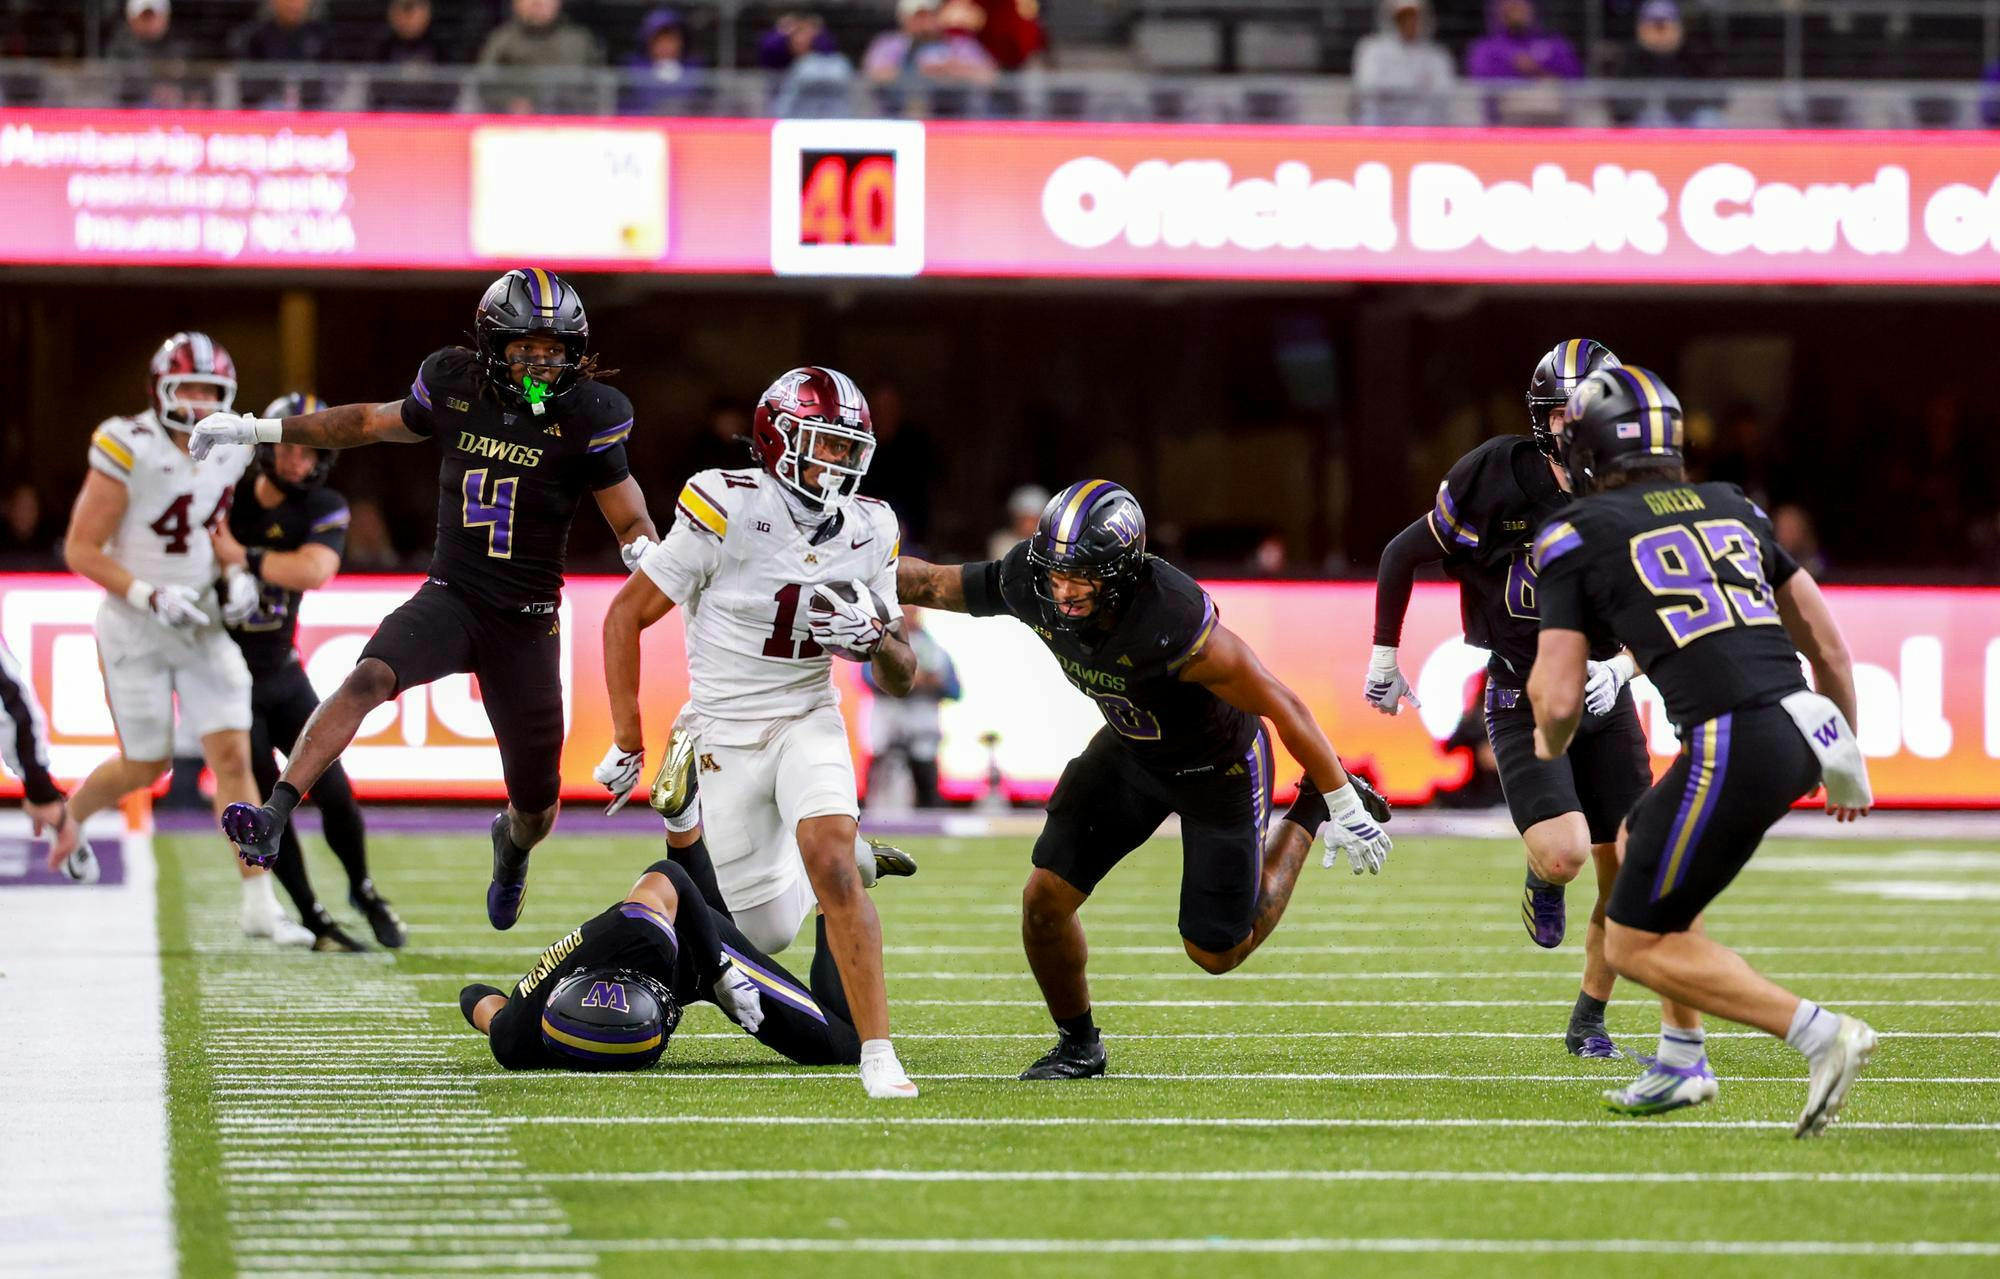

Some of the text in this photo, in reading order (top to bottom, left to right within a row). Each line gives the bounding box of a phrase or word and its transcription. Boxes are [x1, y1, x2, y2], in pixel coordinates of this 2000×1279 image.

[801, 155, 895, 245] 40
[1043, 157, 1397, 252] Official
[1410, 163, 1668, 253] Debit
[1680, 163, 1909, 254] Card
[457, 430, 543, 468] DAWGS
[463, 468, 519, 559] 4
[1103, 500, 1140, 547] W
[1643, 488, 1706, 516] GREEN
[1630, 518, 1782, 648] 93
[1056, 653, 1127, 692] DAWGS
[1813, 716, 1839, 748] W
[518, 927, 584, 999] ROBINSON
[581, 980, 630, 1014] W
